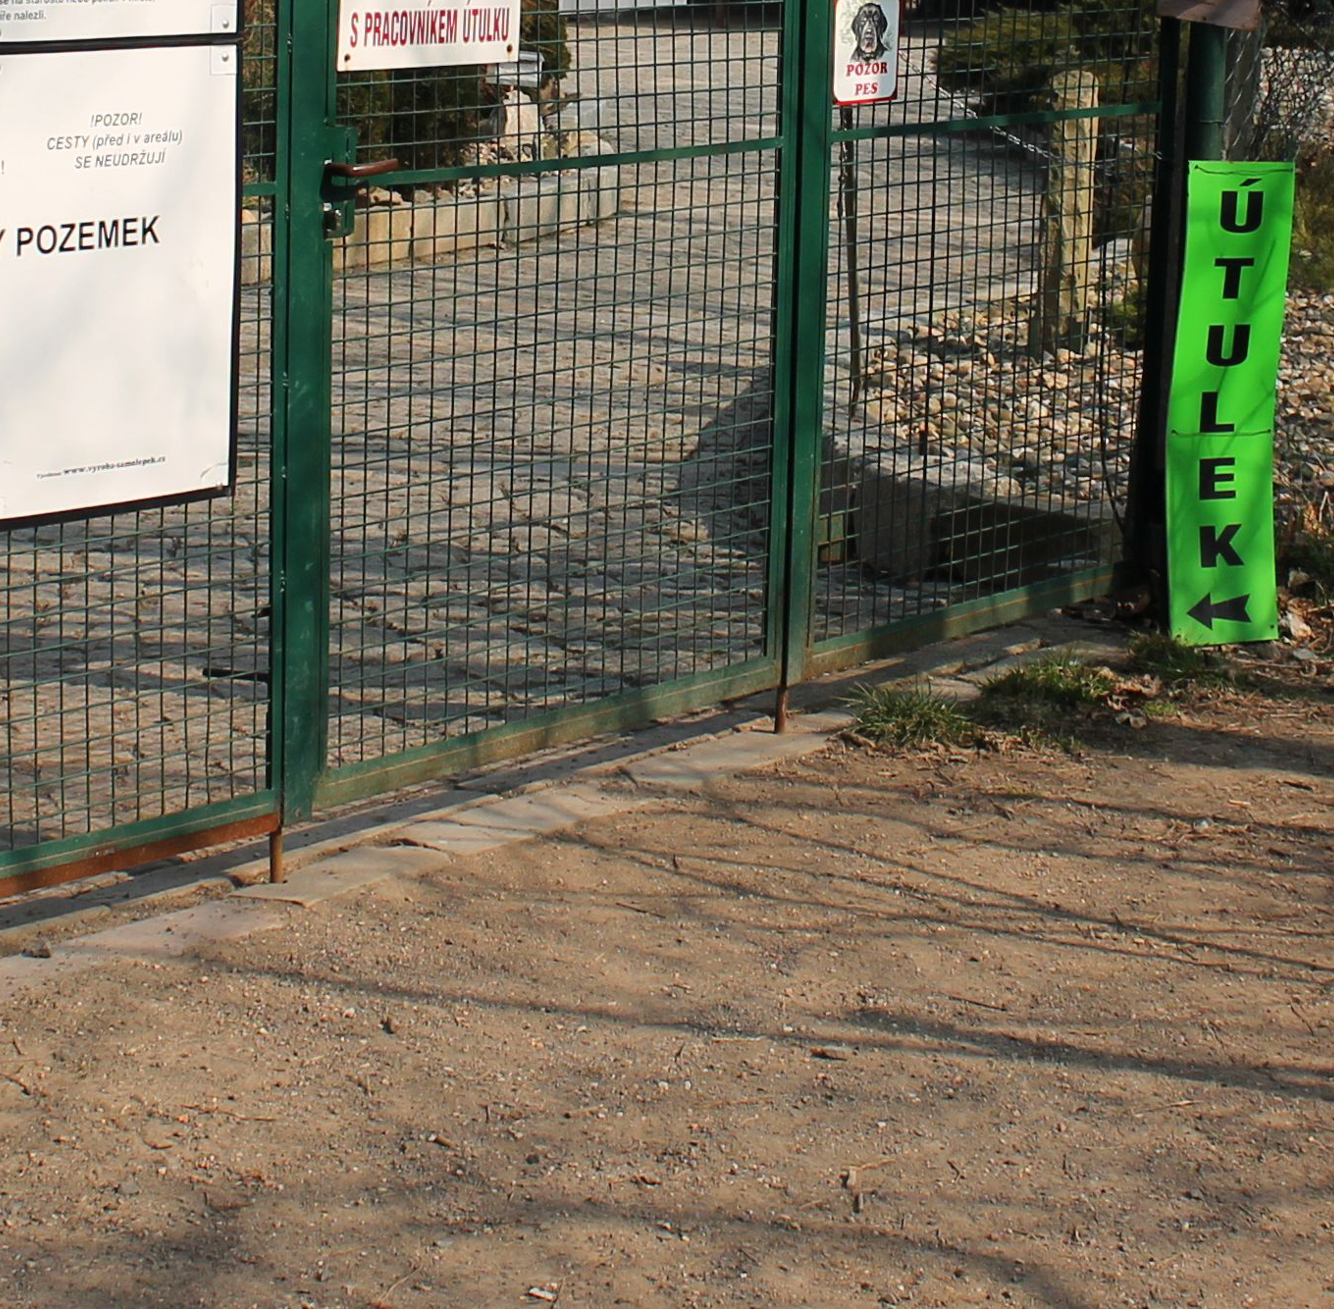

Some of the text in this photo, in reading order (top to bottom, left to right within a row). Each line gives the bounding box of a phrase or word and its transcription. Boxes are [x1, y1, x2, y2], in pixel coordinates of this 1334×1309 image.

[14, 10, 46, 20] nalezli.
[350, 11, 358, 47] S
[364, 0, 457, 46] PRACOVNÍKEM
[846, 62, 888, 76] POZOR
[855, 82, 878, 95] PES
[47, 134, 89, 151] CESTY
[92, 132, 124, 150] (před
[133, 136, 140, 145] v
[143, 129, 183, 146] areálu)
[74, 149, 166, 169] SE NEUDRŽUJÍ
[16, 214, 161, 257] POZEMEK
[1198, 177, 1266, 569] ÚTULEK
